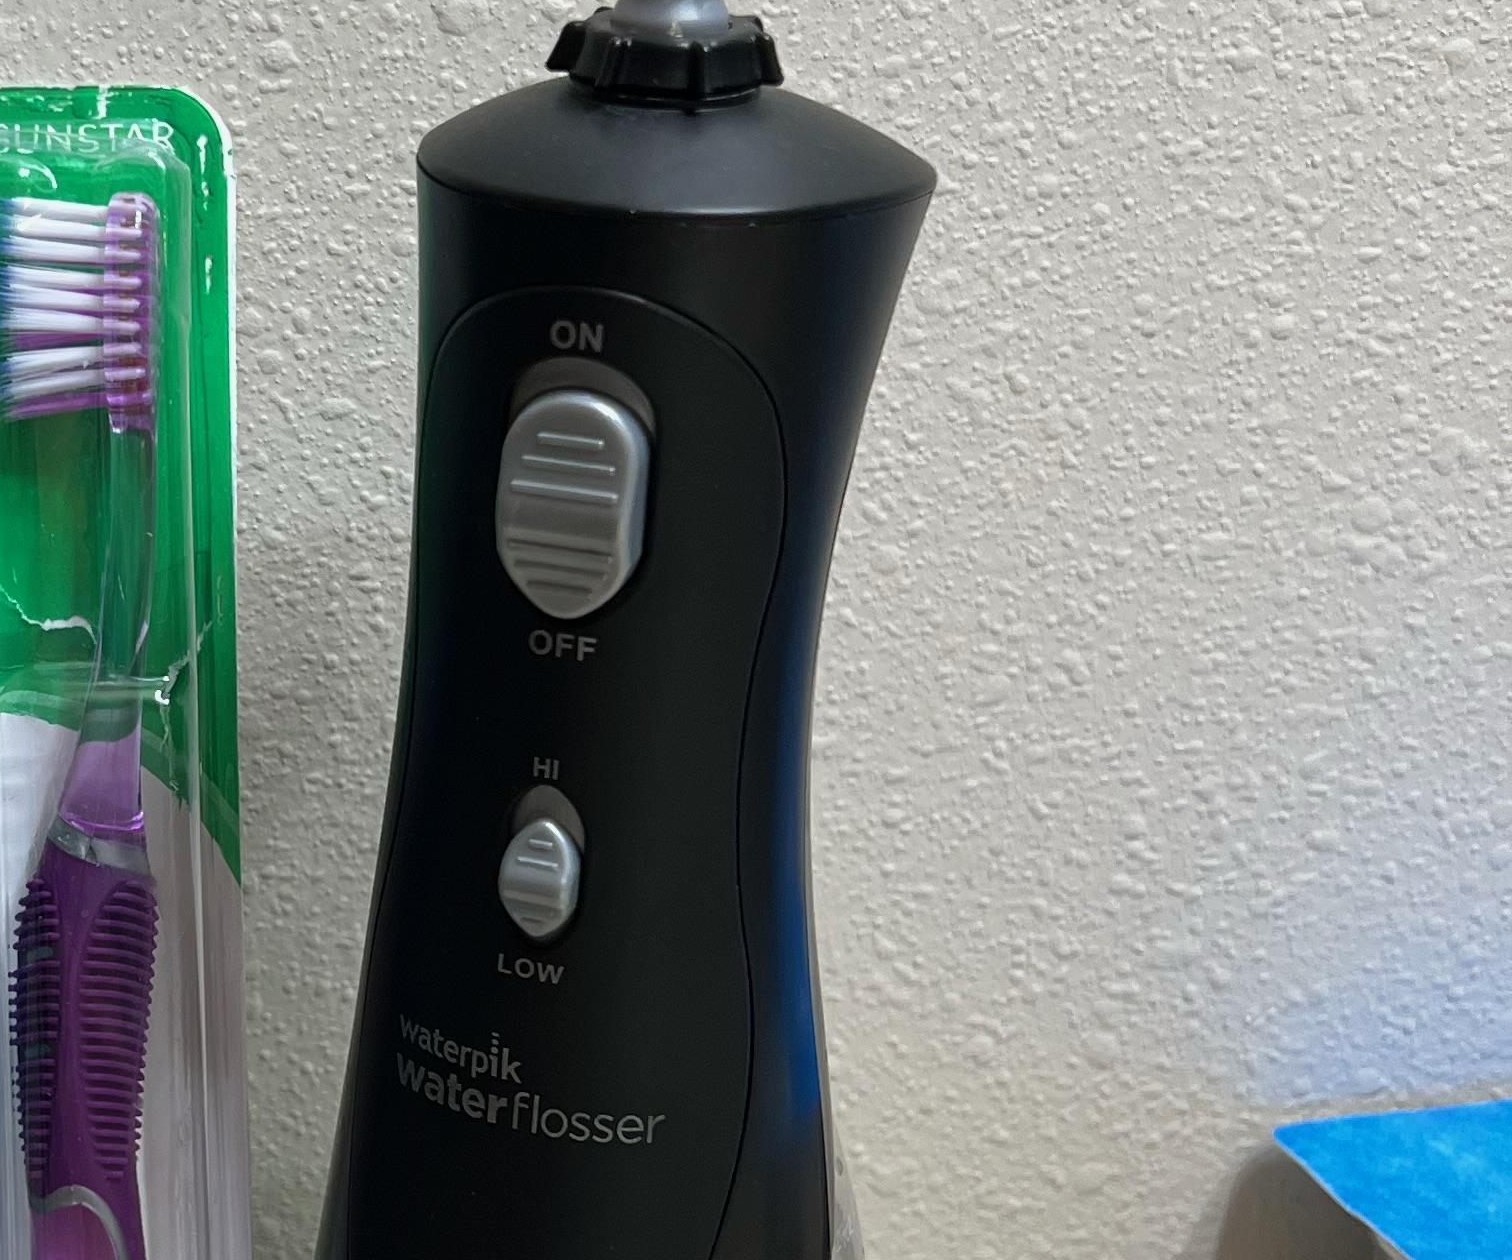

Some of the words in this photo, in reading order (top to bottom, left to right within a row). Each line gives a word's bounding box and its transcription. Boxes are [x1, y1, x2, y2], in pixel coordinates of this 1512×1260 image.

[549, 320, 604, 353] ON
[528, 629, 597, 662] OFF
[533, 757, 559, 780] HI
[497, 953, 565, 984] LOW
[399, 1013, 522, 1084] waterpik
